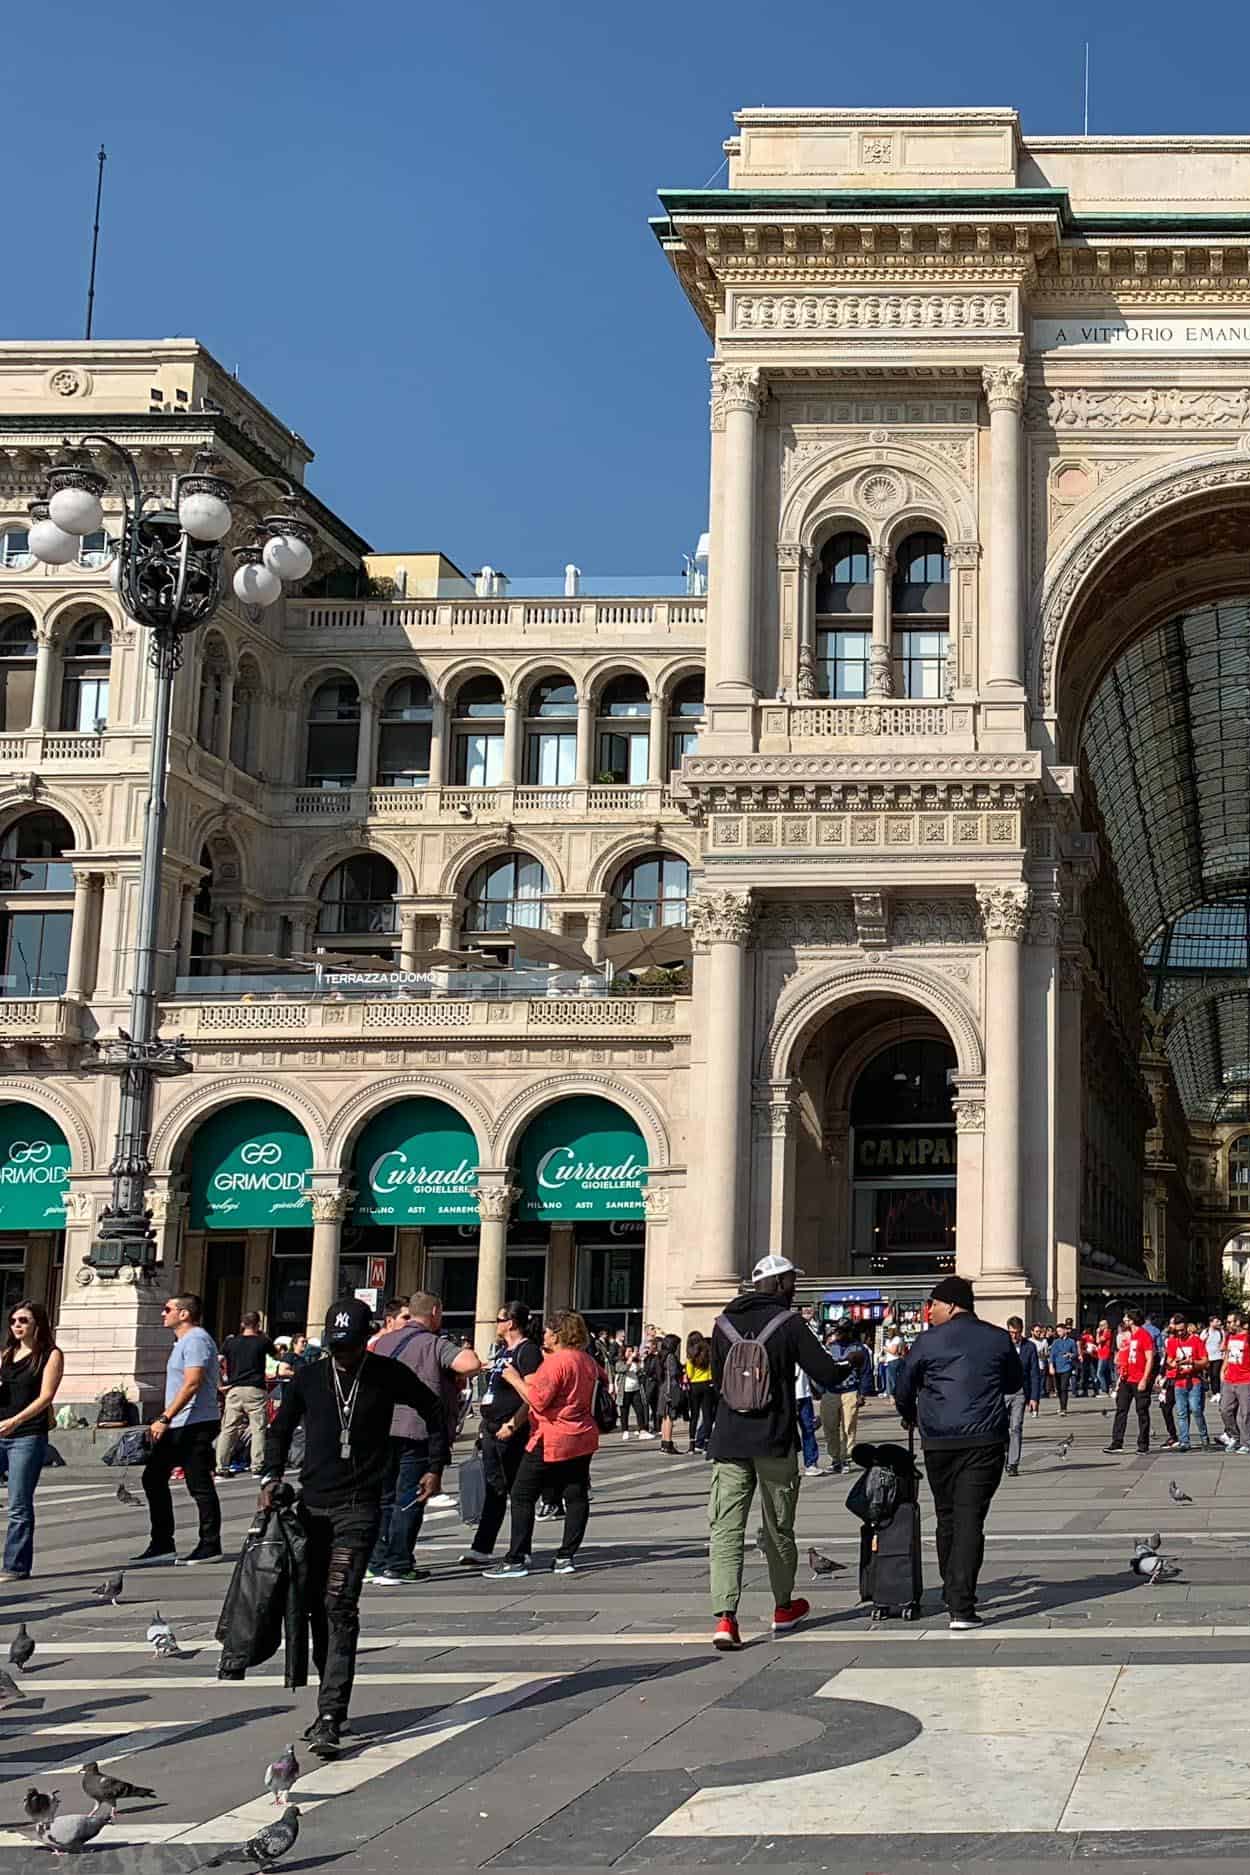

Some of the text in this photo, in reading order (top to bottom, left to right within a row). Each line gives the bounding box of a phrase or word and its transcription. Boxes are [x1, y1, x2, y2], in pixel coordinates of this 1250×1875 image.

[1055, 329, 1067, 341] A
[1082, 328, 1173, 342] VITTORIO
[324, 972, 435, 985] TERRAZZA DUOMO
[862, 1138, 956, 1166] CAMPA
[369, 1150, 476, 1194] Currado
[536, 1146, 642, 1189] Currado
[214, 1172, 305, 1191] GRIMOLDI
[581, 1180, 641, 1189] GIOIELLERIE
[407, 1206, 426, 1214] ASTI
[438, 1206, 481, 1214] SANREMO
[527, 1200, 649, 1209] MILANO ASTI SANREMO
